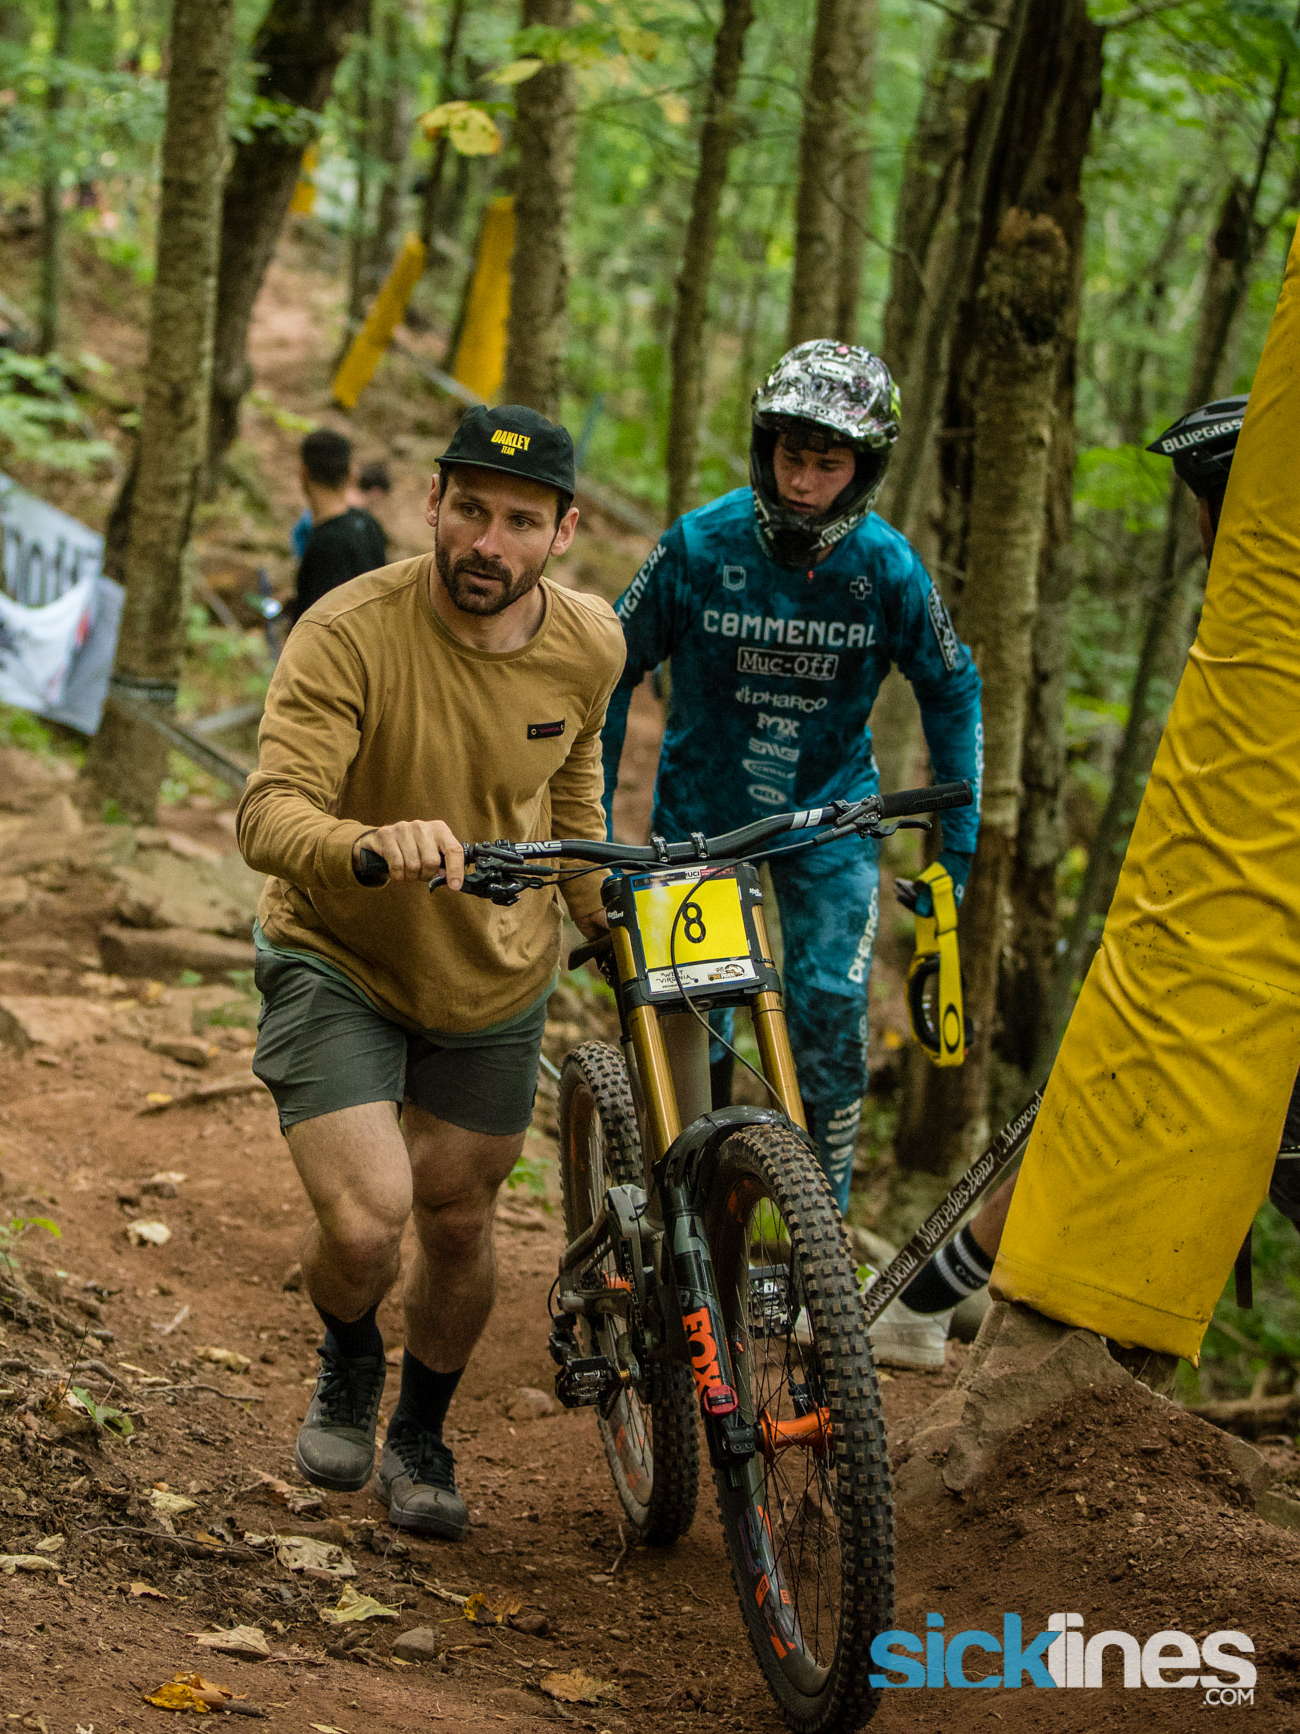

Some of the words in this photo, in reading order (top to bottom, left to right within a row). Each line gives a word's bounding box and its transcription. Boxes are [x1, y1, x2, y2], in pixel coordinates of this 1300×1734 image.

[490, 429, 531, 451] OAKLEY
[1161, 418, 1245, 454] BLUeGras
[500, 445, 515, 456] TEAM
[703, 609, 876, 648] COMMENCAL
[741, 651, 834, 677] Muc-Off
[756, 711, 801, 738] FOX
[683, 901, 706, 944] 8
[656, 974, 695, 984] VIRGNIA
[661, 970, 684, 978] WET
[916, 1152, 994, 1250] Mercedes-Benz
[682, 1307, 723, 1400] FOX
